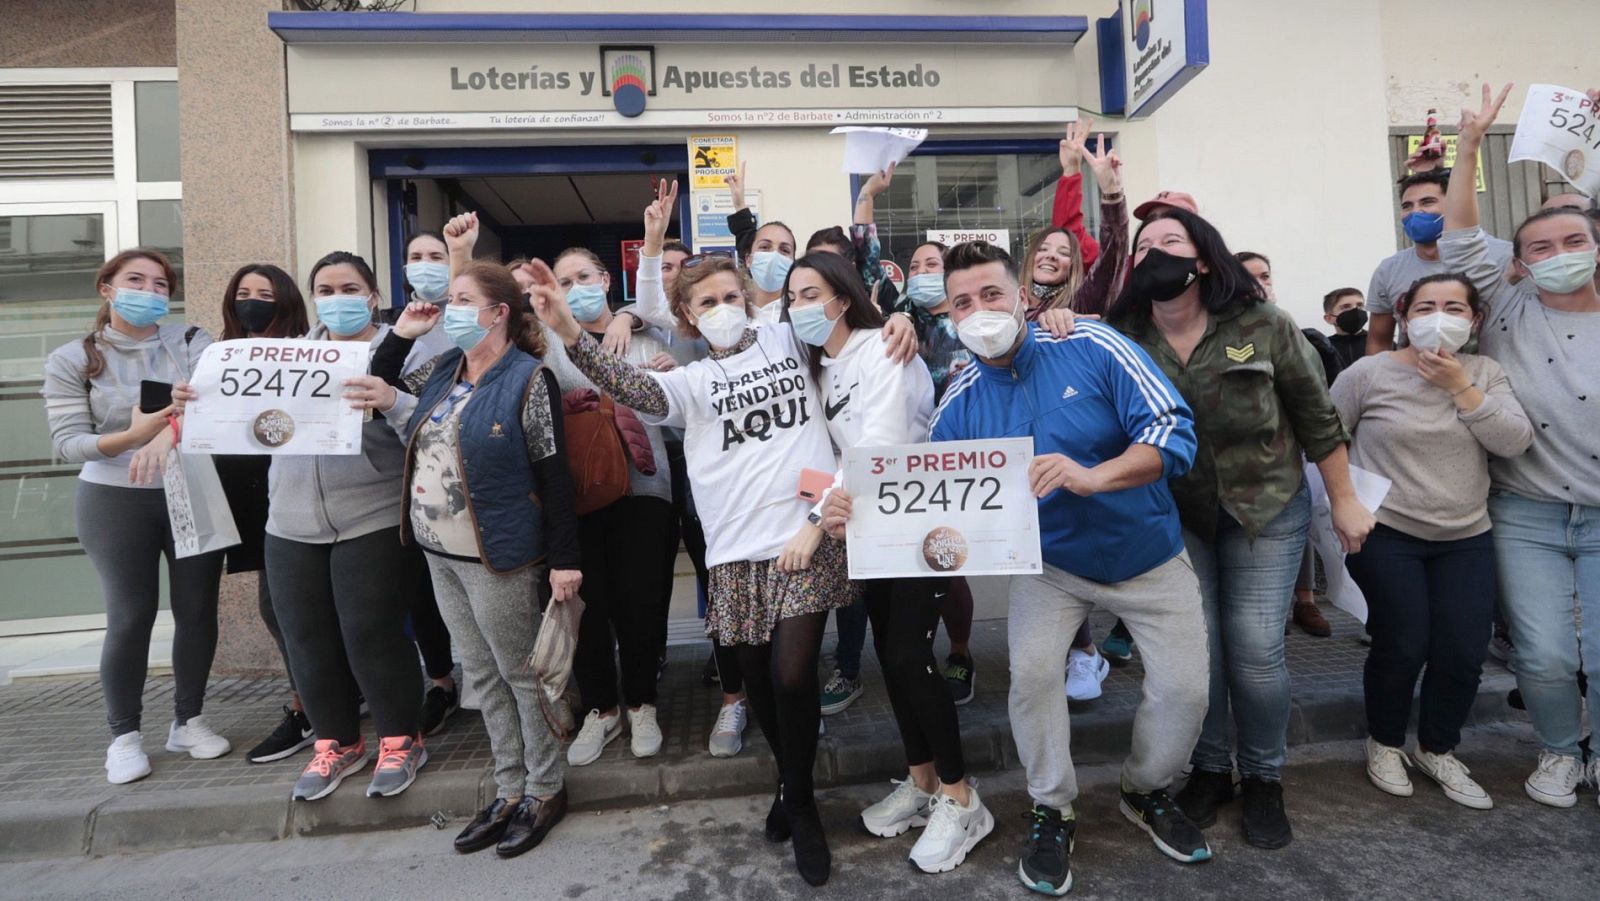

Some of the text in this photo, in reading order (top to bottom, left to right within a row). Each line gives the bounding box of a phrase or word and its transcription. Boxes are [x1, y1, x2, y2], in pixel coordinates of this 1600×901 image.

[450, 63, 940, 96] Loterías y Apuestas del Estado
[322, 118, 353, 126] Somos
[356, 117, 365, 126] la
[397, 117, 409, 126] de
[505, 115, 536, 124] lotería
[540, 114, 551, 123] de
[708, 112, 742, 122] Somos
[745, 112, 754, 121] la
[777, 112, 791, 121] de
[793, 111, 834, 121] Barbate
[844, 110, 921, 121] Administración
[936, 110, 943, 120] 2
[954, 233, 997, 242] PREMIO
[220, 346, 340, 363] 3er PREMIO
[220, 368, 331, 398] 52472
[727, 357, 799, 393] PREMIO
[712, 374, 806, 416] VENDIDO
[871, 450, 1007, 474] 3er PREMIO
[878, 476, 1003, 515] 52472
